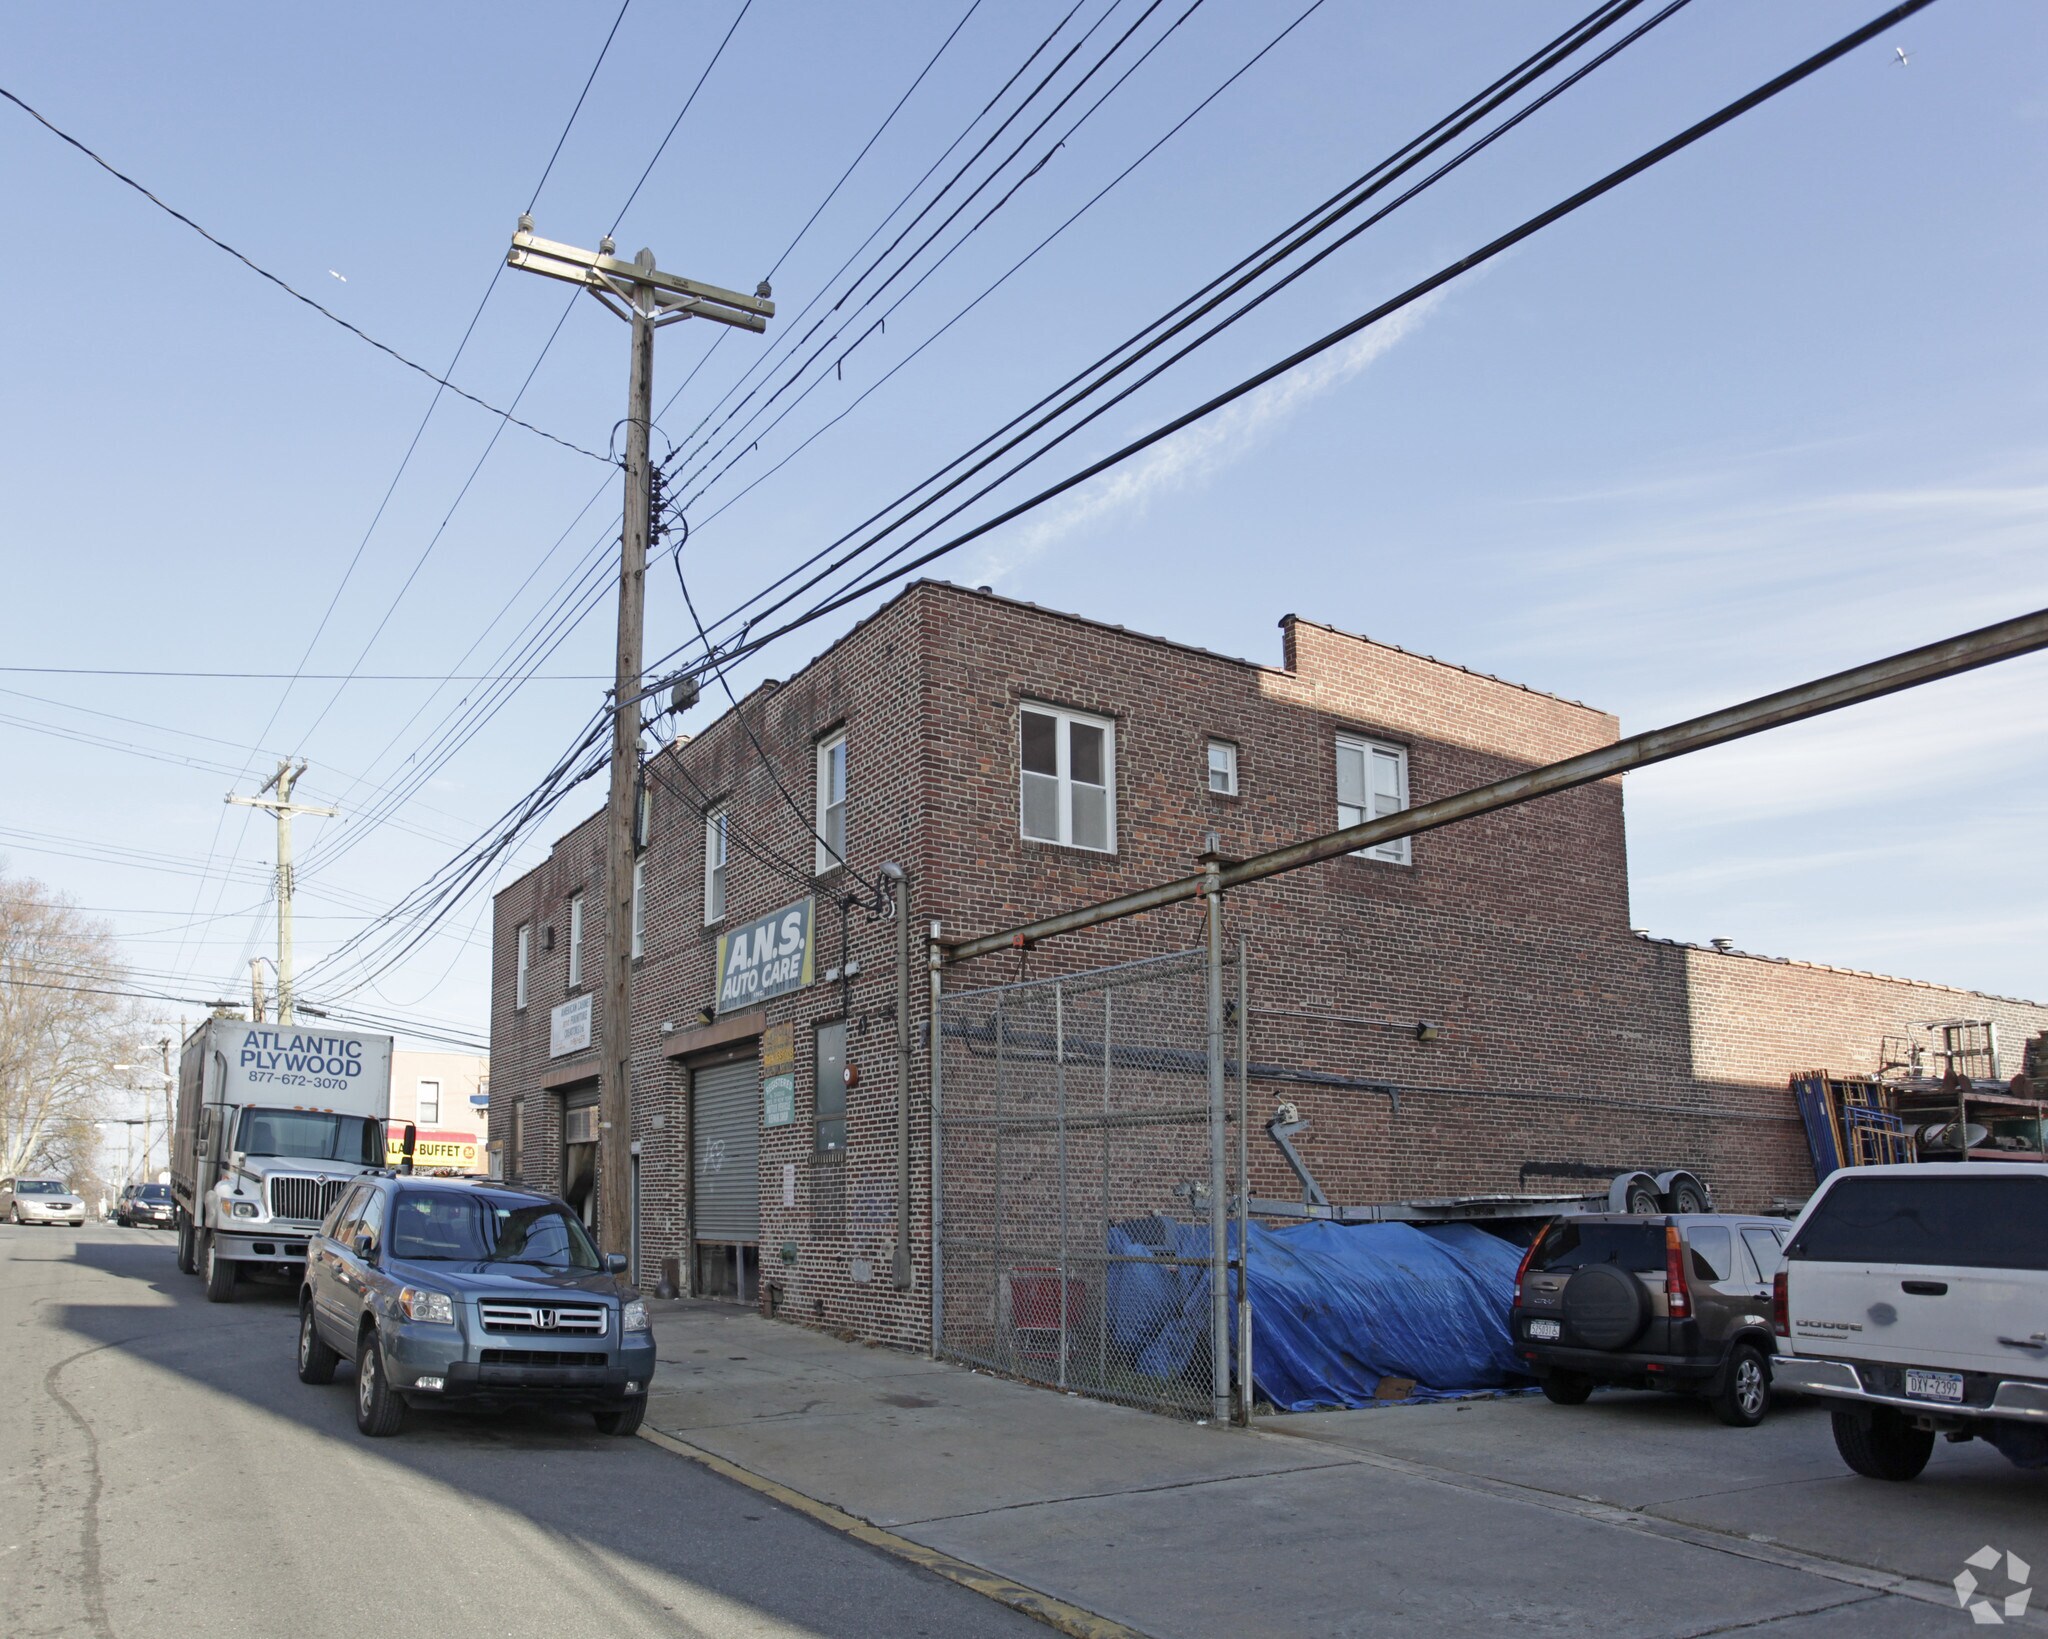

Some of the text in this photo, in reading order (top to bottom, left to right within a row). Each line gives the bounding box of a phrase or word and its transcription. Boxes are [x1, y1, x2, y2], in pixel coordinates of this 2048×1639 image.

[727, 911, 805, 976] A.N.S.
[722, 953, 801, 1001] AUTO CARE
[243, 1031, 362, 1059] ATLANTIC
[240, 1050, 362, 1077] PLYWOOD
[248, 1071, 348, 1091] 877-672-3070
[419, 1144, 460, 1157] BUFFET
[1796, 1320, 1863, 1332] DODGE
